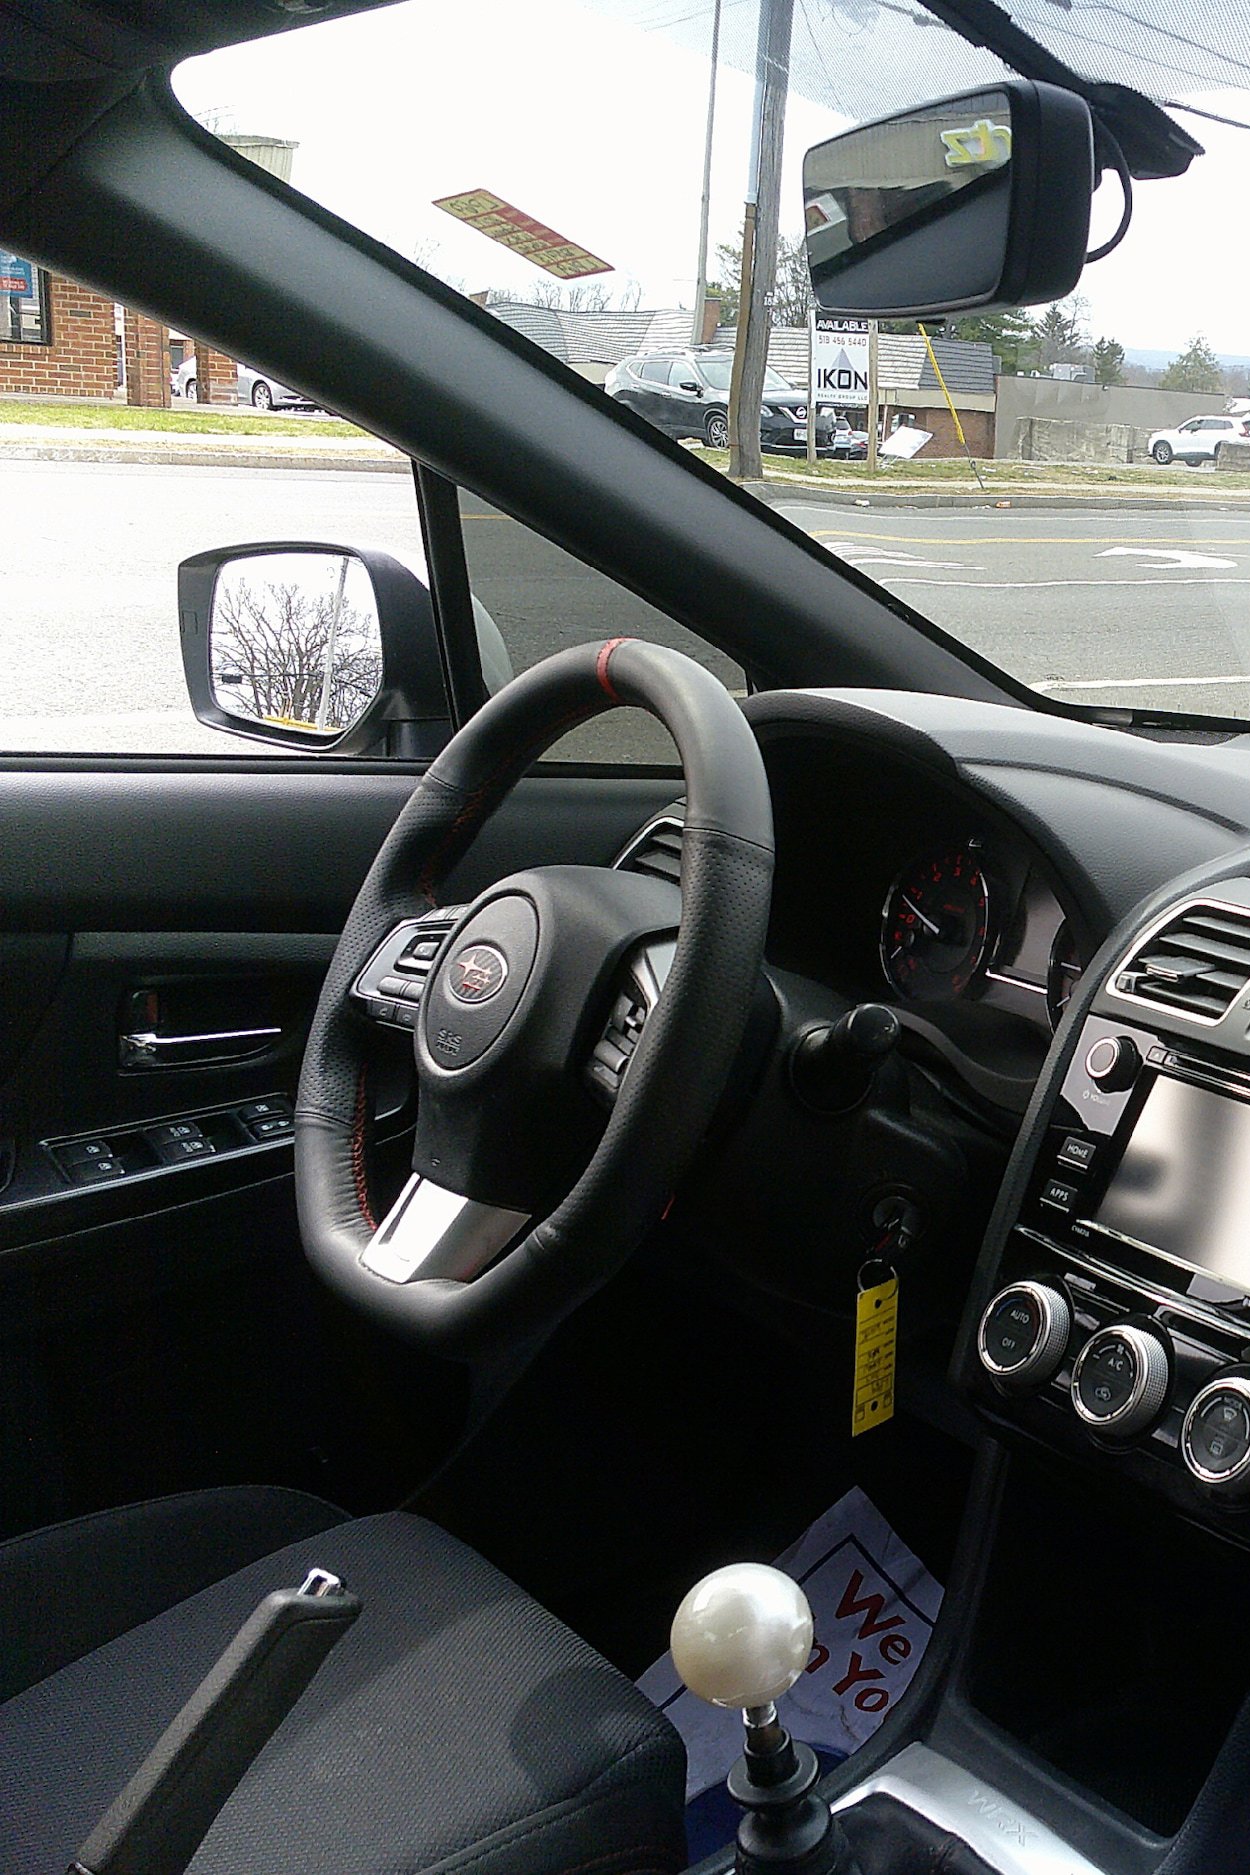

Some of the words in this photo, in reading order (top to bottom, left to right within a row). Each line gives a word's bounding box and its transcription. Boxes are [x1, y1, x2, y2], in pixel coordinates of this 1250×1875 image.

[816, 319, 868, 331] AVAILABLE
[817, 368, 868, 390] IKON
[1066, 1144, 1089, 1159] HOME
[1050, 1186, 1069, 1202] APPS
[1010, 1309, 1030, 1325] AUTO
[1001, 1337, 1016, 1349] OFF
[1107, 1358, 1124, 1372] A/C
[835, 1568, 911, 1666] We
